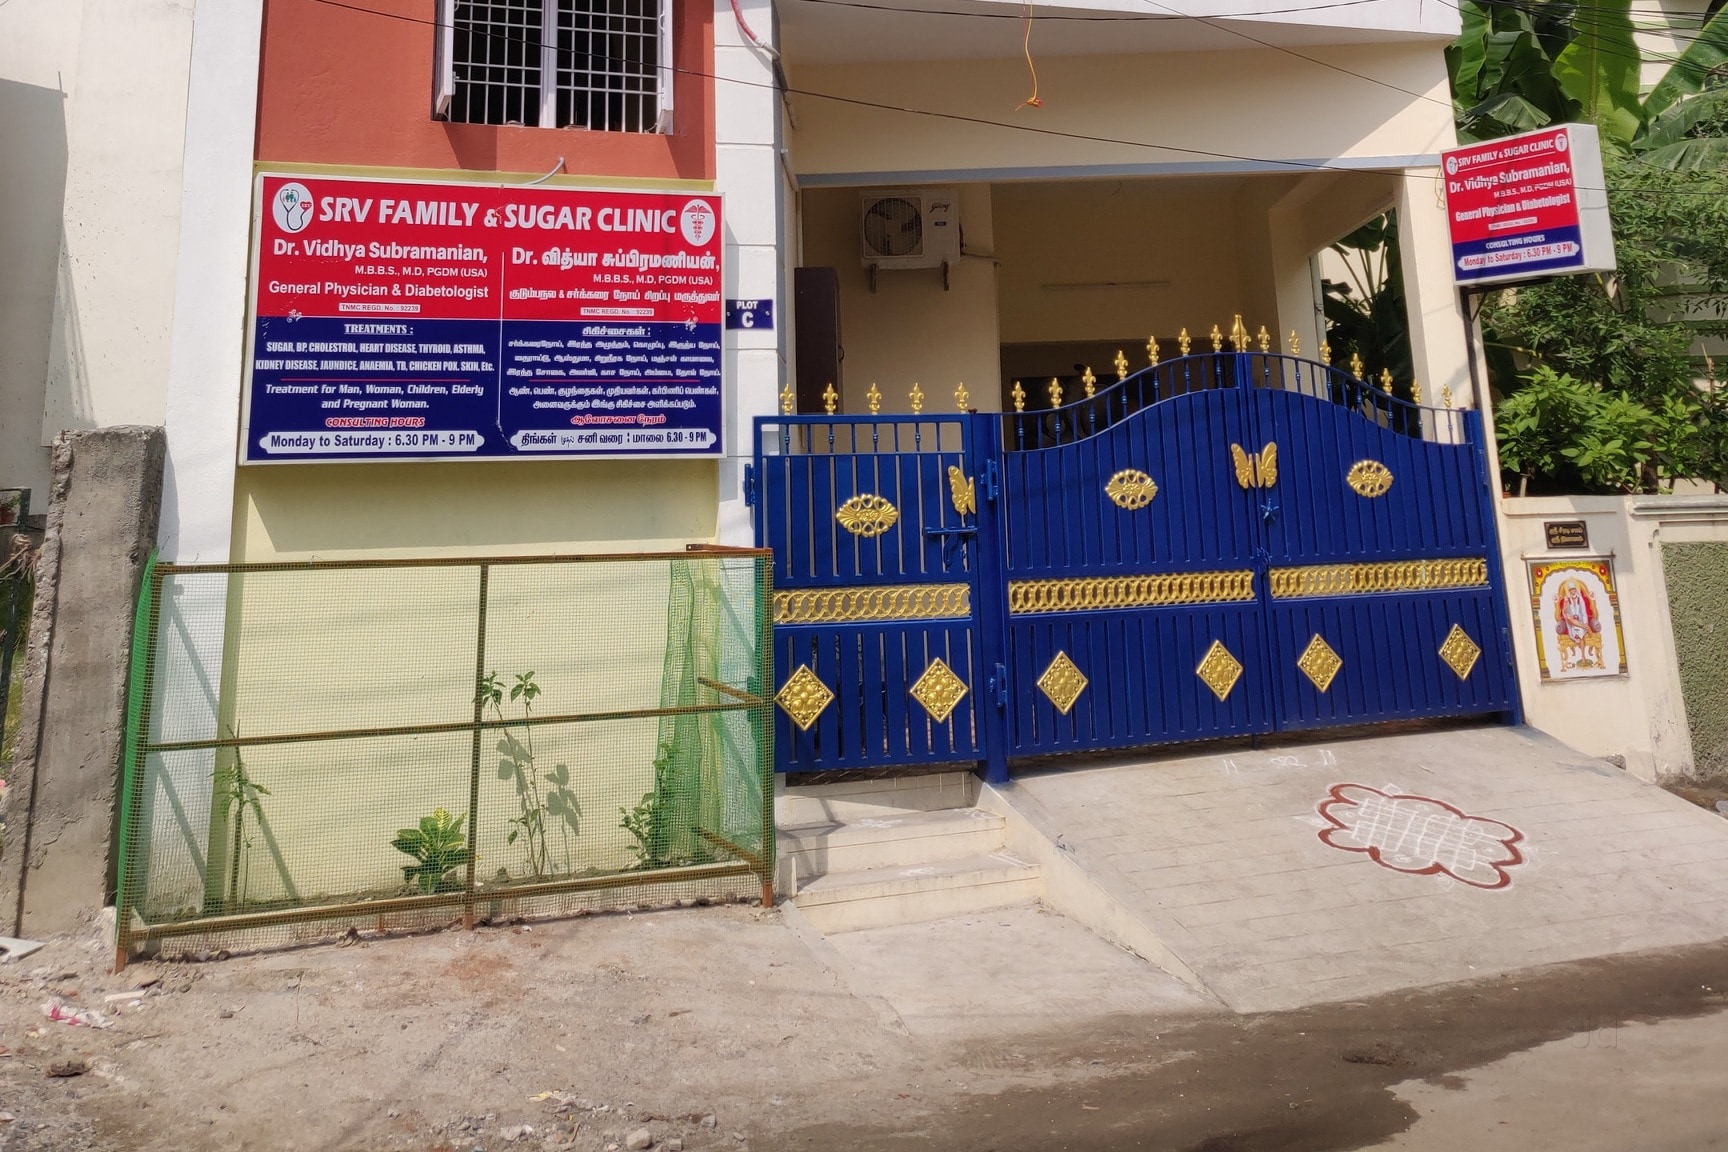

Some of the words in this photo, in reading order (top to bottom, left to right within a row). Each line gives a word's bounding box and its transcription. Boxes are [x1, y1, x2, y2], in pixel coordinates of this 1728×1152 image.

[1458, 156, 1471, 167] SRV
[1472, 151, 1498, 164] FAMILY
[1504, 145, 1529, 157] SUGAR
[1530, 139, 1554, 152] CLINIC
[1450, 181, 1464, 193] Dr.
[1464, 177, 1498, 191] Vidhya
[1499, 162, 1570, 183] Subramanian,
[319, 196, 374, 224] SRV
[378, 199, 480, 228] FAMILY
[483, 208, 498, 228] &
[504, 203, 592, 231] SUGAR
[597, 207, 677, 234] CLINIC
[1456, 206, 1481, 222] General
[1482, 202, 1515, 218] Physician
[1516, 202, 1521, 211] &
[1522, 193, 1570, 210] Diabetologist
[1486, 237, 1522, 249] CONSULTING
[1523, 234, 1545, 246] HOURS
[273, 239, 299, 256] Dr.
[303, 239, 365, 262] Vidhya
[368, 242, 488, 264] Subramanian,
[1464, 255, 1486, 267] Monday
[1487, 255, 1494, 263] to
[1495, 251, 1522, 263] Saturday
[1527, 248, 1540, 258] 6.30
[1542, 245, 1552, 255] PM
[1562, 243, 1573, 253] PM
[512, 247, 537, 265] Dr.
[541, 247, 598, 271] வித்யா
[602, 248, 720, 272] சுப்பிரமணியன்,
[427, 267, 458, 277] PGDM
[460, 267, 488, 278] (USA)
[658, 275, 687, 285] PGDM
[688, 275, 713, 286] (USA)
[269, 281, 321, 294] General
[324, 283, 388, 298] Physician
[391, 285, 401, 296] &
[405, 284, 489, 300] Diabetologist
[558, 289, 565, 299] &
[566, 287, 609, 301] சர்க்கரை
[613, 289, 640, 302] நோய்
[644, 290, 670, 303] சிறப்பு
[674, 290, 720, 304] மருத்துவர்
[736, 301, 758, 310] PLOT
[742, 311, 754, 328] C
[344, 324, 407, 334] TREATMENTS
[582, 326, 645, 336] சிகிச்சைகள்
[266, 341, 295, 353] SUGAR,
[296, 342, 308, 353] BP,
[308, 342, 359, 353] CHOLESTROL,
[359, 343, 384, 353] HEART
[385, 343, 417, 354] DISEASE,
[419, 343, 452, 354] THYROID,
[453, 344, 486, 355] ASTHMA,
[255, 360, 284, 370] KIDNEY
[285, 360, 319, 371] DISEASE,
[320, 360, 359, 371] JAUNDICE,
[359, 361, 395, 371] ANAEMIA,
[396, 361, 408, 371] TB,
[409, 361, 441, 371] CHICKEN
[460, 361, 480, 372] SKIN,
[481, 362, 495, 372] Etc.
[265, 384, 319, 394] Treatment
[321, 384, 336, 394] for
[338, 385, 362, 396] Man,
[366, 385, 404, 396] Woman,
[407, 385, 449, 396] Children,
[451, 385, 484, 397] Elderly
[321, 399, 341, 409] and
[343, 399, 388, 411] Pregnant
[391, 399, 430, 409] Woman.
[324, 416, 388, 428] CONSULTING
[389, 416, 425, 428] HOURS
[637, 413, 667, 425] நேரம்
[270, 435, 316, 450] Monday
[319, 435, 330, 447] to
[334, 434, 385, 449] Saturday
[395, 434, 418, 446] 6.30
[421, 434, 439, 446] PM
[449, 434, 455, 446] 9
[458, 434, 475, 446] PM
[521, 431, 557, 447] திங்கள்
[577, 432, 598, 444] சனி
[600, 433, 623, 445] வரை
[632, 433, 664, 444] மாலை
[666, 431, 683, 443] 6.30
[689, 431, 694, 443] 9
[695, 431, 707, 442] PM
